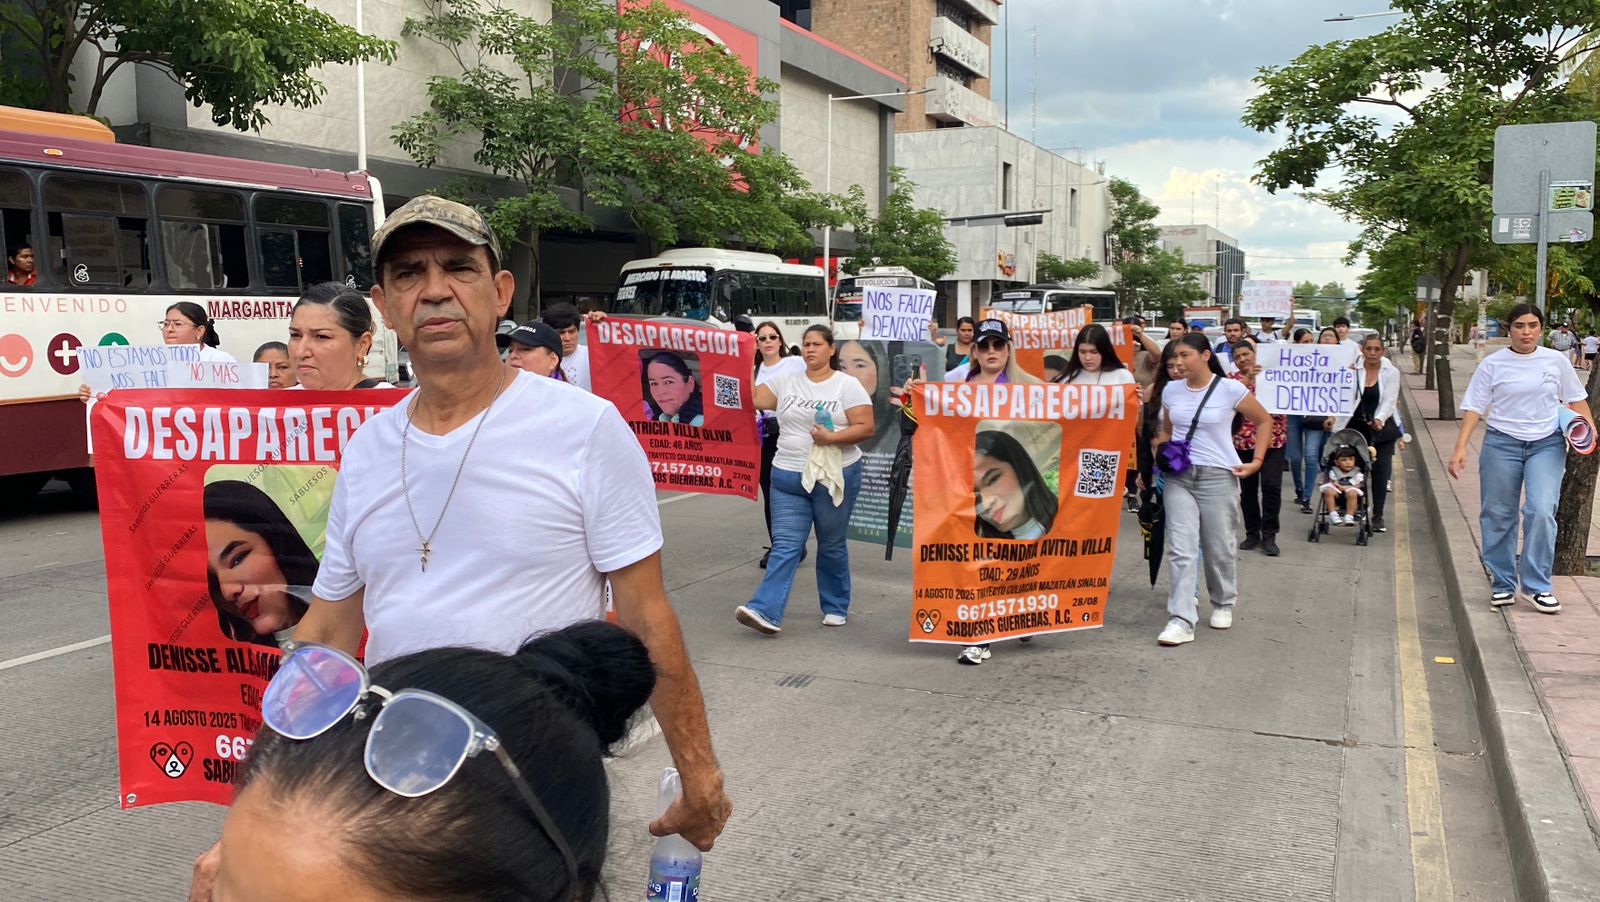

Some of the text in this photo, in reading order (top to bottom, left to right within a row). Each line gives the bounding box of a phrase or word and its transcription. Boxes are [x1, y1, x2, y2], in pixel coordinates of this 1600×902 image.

[671, 270, 707, 283] ABASTOS
[866, 290, 933, 315] NOS FALTA
[598, 321, 740, 357] DESAPARECIDA
[872, 314, 929, 342] DENISSE
[109, 347, 167, 368] ESTAMOS
[1279, 349, 1329, 367] Hasta
[111, 373, 135, 389] NOS
[1265, 366, 1353, 384] encontrarte
[924, 384, 1126, 420] DESAPARECIDA
[1276, 385, 1351, 413] DENISSE
[629, 421, 733, 443] ATRICIA VILLA OLIVA
[649, 438, 672, 449] EDAD:
[649, 461, 722, 477] 71571930
[289, 466, 328, 505] SABUESOS
[164, 524, 198, 563] GUERRERAS
[921, 537, 1112, 563] DENISSE ALEJANDRA AVITIA VILLA
[979, 563, 1040, 582] EDAD: 29 AÑOS
[915, 588, 923, 600] 14
[924, 588, 953, 599] AGOSTO
[955, 589, 975, 600] 2025
[1077, 577, 1106, 588] SINALOA
[957, 593, 1059, 620] 6671571930
[1072, 596, 1098, 607] 28/08
[946, 618, 995, 638] SABUESOS
[1055, 608, 1073, 625] A.C.
[148, 643, 223, 673] DENISSE
[144, 710, 160, 727] 14
[164, 710, 207, 727] AGOSTO
[210, 712, 237, 729] 2025
